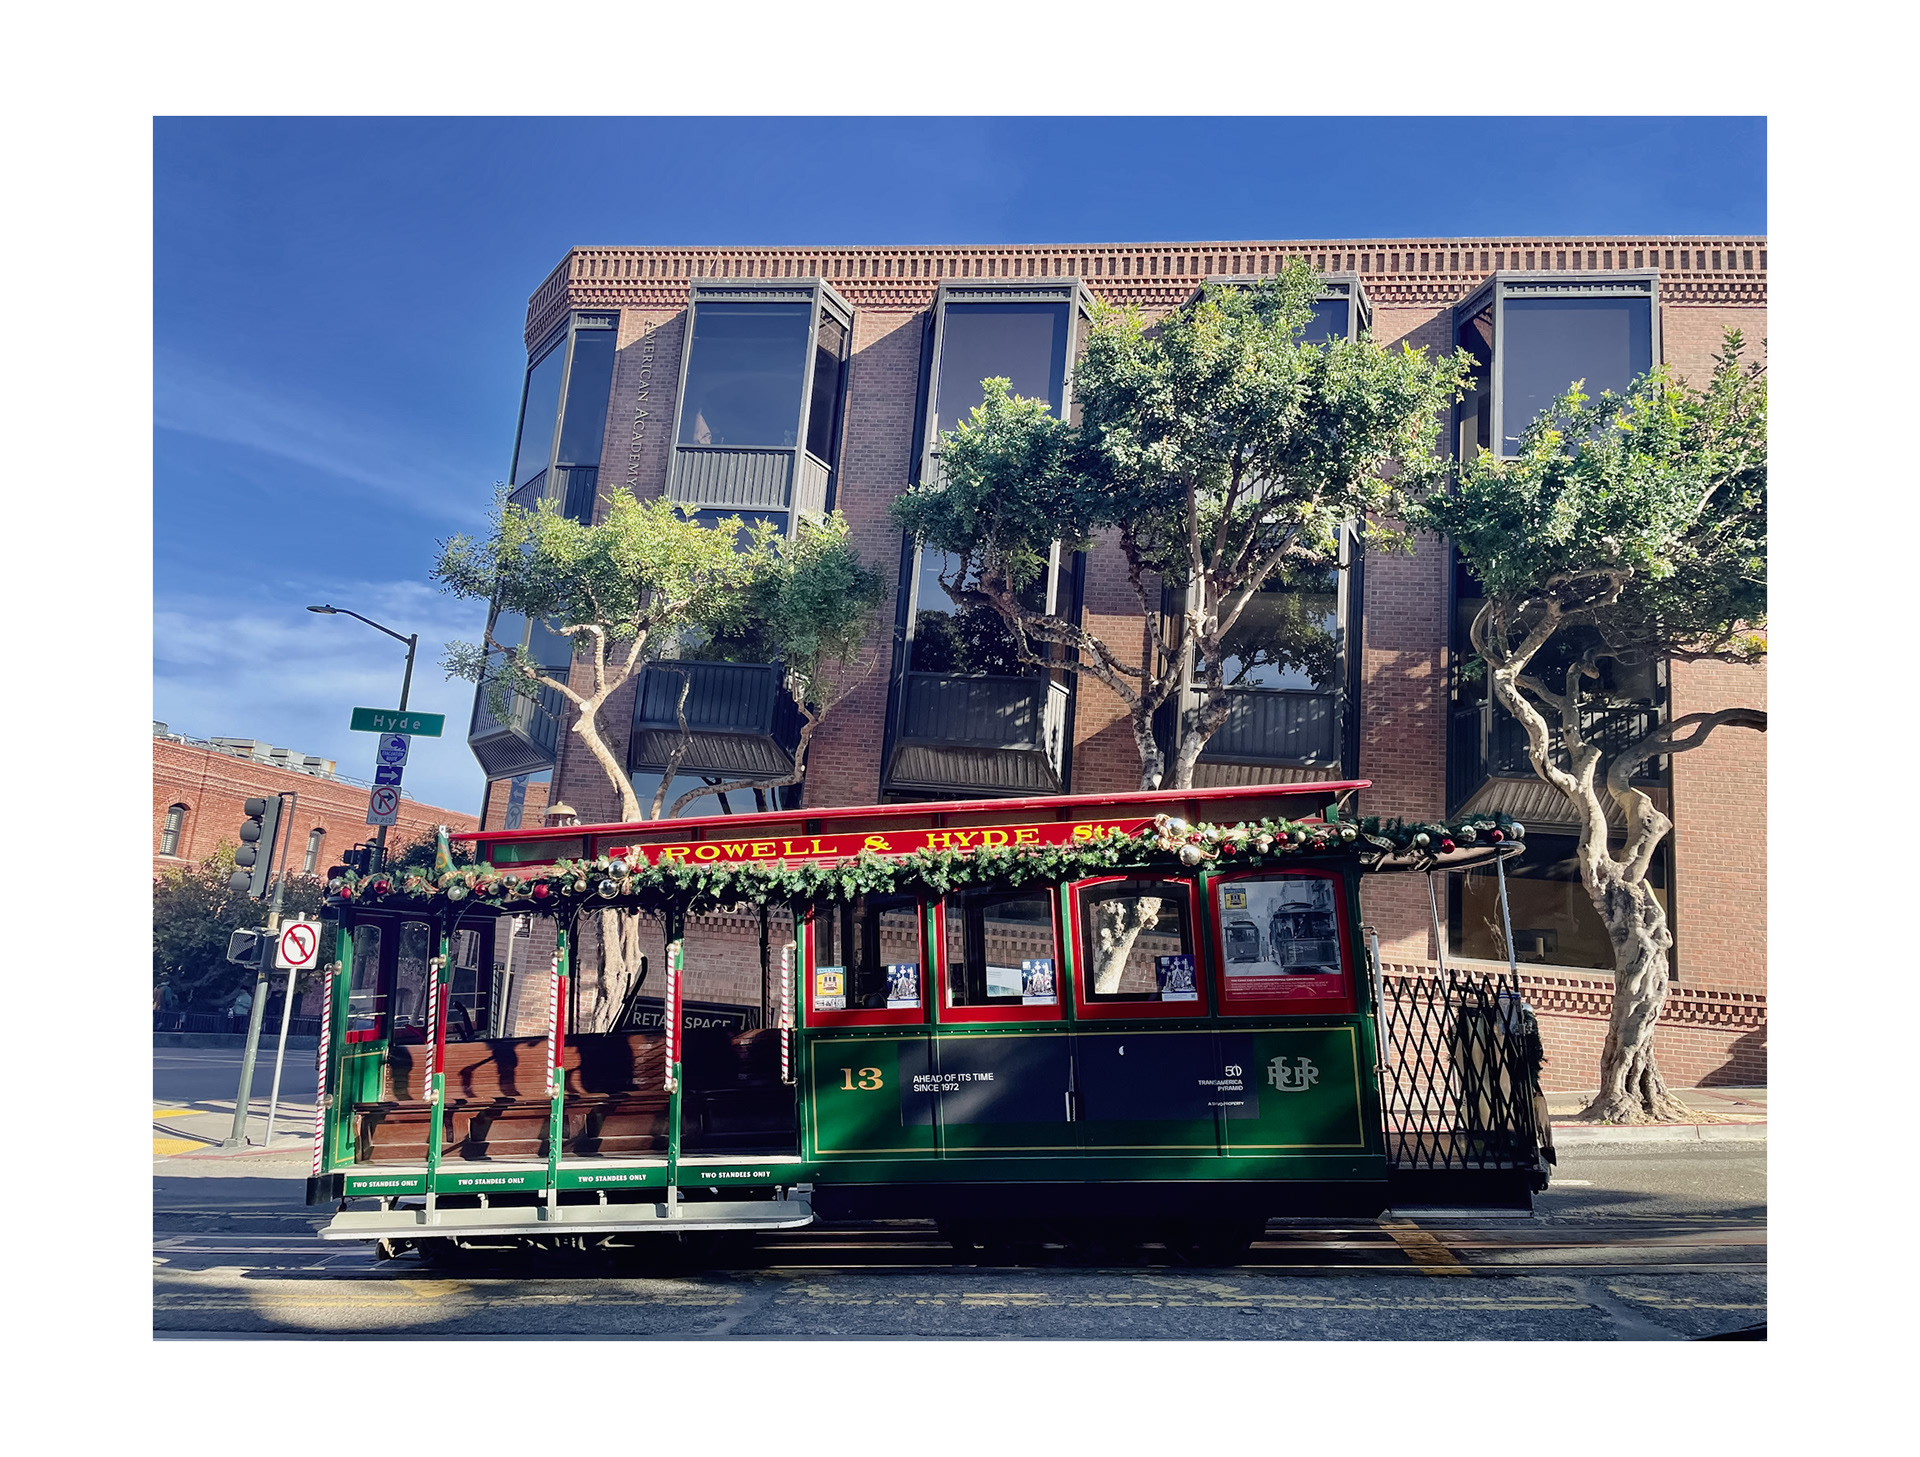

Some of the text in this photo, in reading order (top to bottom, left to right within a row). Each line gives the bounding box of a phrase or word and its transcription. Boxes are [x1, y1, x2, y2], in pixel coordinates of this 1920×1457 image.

[637, 320, 657, 402] AMERICAN
[626, 407, 649, 487] ACADEMY
[373, 714, 421, 730] Hyde
[663, 839, 838, 860] POWELL
[864, 836, 892, 852] &
[926, 828, 1040, 848] HYDE
[632, 1012, 668, 1027] RETA
[840, 1067, 884, 1090] 13
[913, 1072, 994, 1083] AHEAD OF ITS TIME
[913, 1083, 960, 1092] SINCE 1972
[718, 1171, 752, 1179] STANDEES
